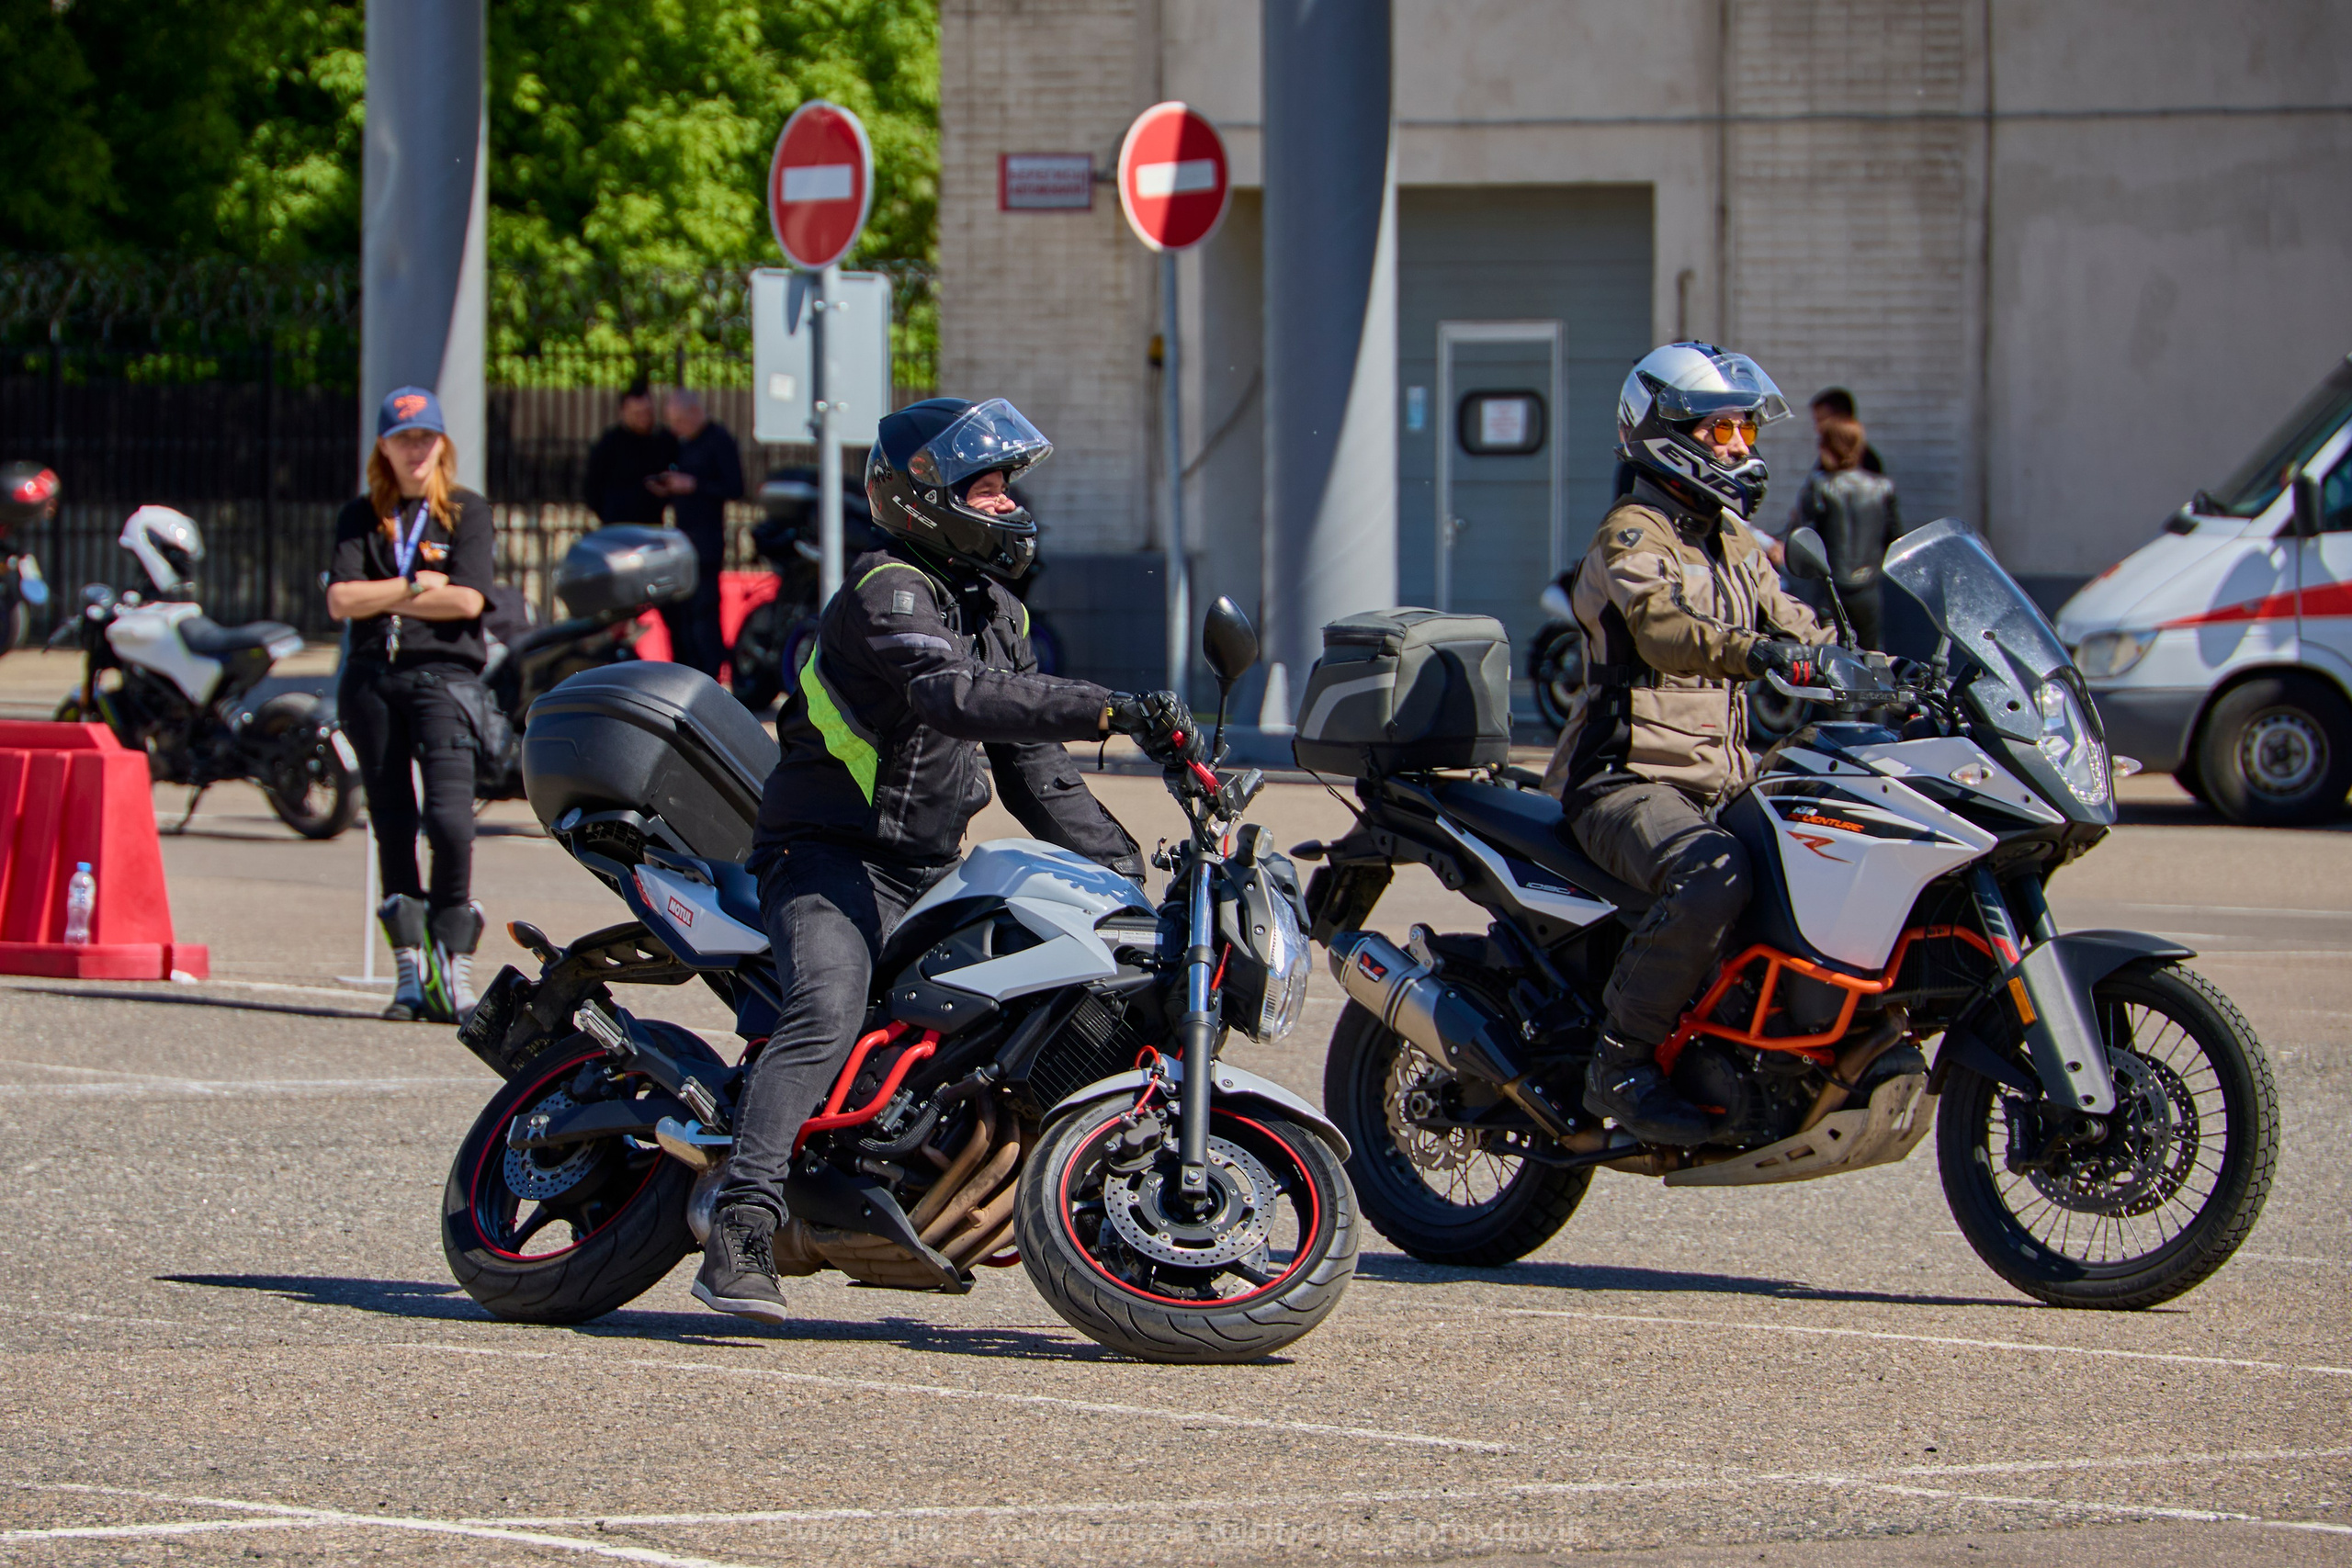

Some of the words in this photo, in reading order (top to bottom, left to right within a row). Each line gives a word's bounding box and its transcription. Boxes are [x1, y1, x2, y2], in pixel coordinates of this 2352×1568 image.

[1657, 443, 1741, 501] EVO
[892, 495, 938, 530] LS2
[669, 898, 691, 926] MOTUL
[2013, 1118, 2021, 1149] brembo
